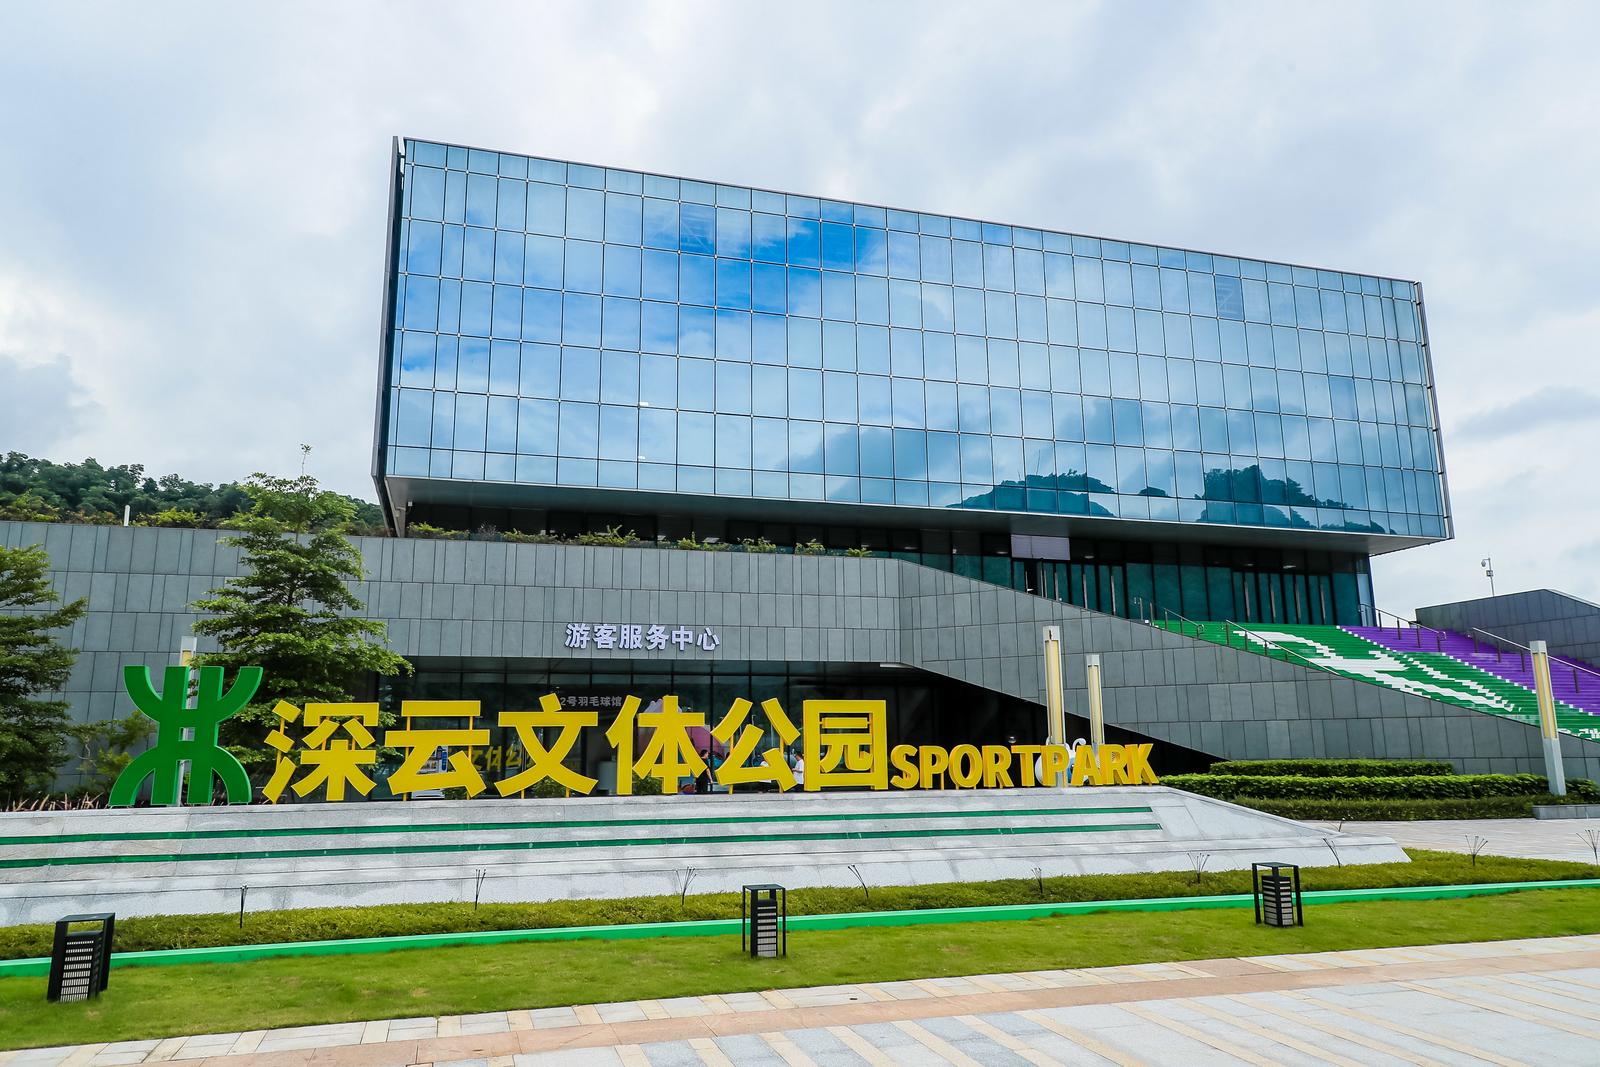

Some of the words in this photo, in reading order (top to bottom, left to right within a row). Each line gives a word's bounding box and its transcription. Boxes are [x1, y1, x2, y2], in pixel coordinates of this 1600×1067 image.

[564, 623, 720, 651] 游客服务中心
[560, 695, 622, 707] 2号羽毛球馆
[262, 693, 889, 803] 深云文体公园
